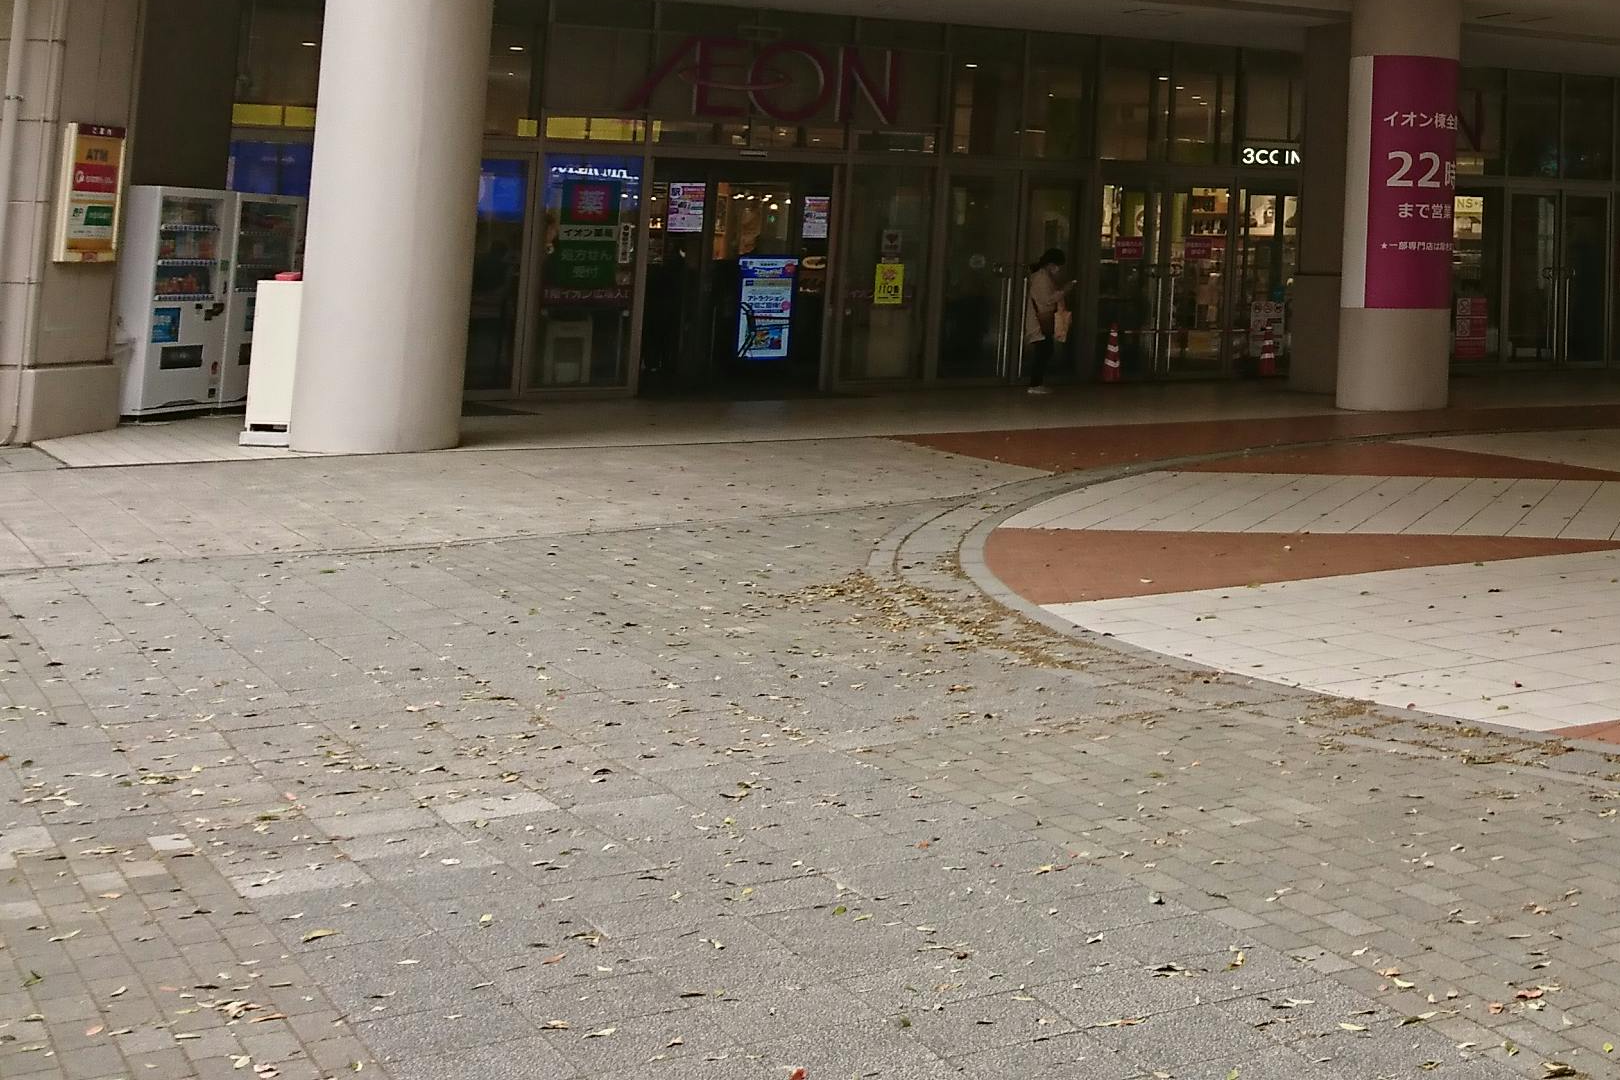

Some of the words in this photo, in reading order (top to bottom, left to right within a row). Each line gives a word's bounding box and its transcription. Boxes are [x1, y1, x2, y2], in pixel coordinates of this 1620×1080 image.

[1383, 111, 1458, 131] イオン棟全
